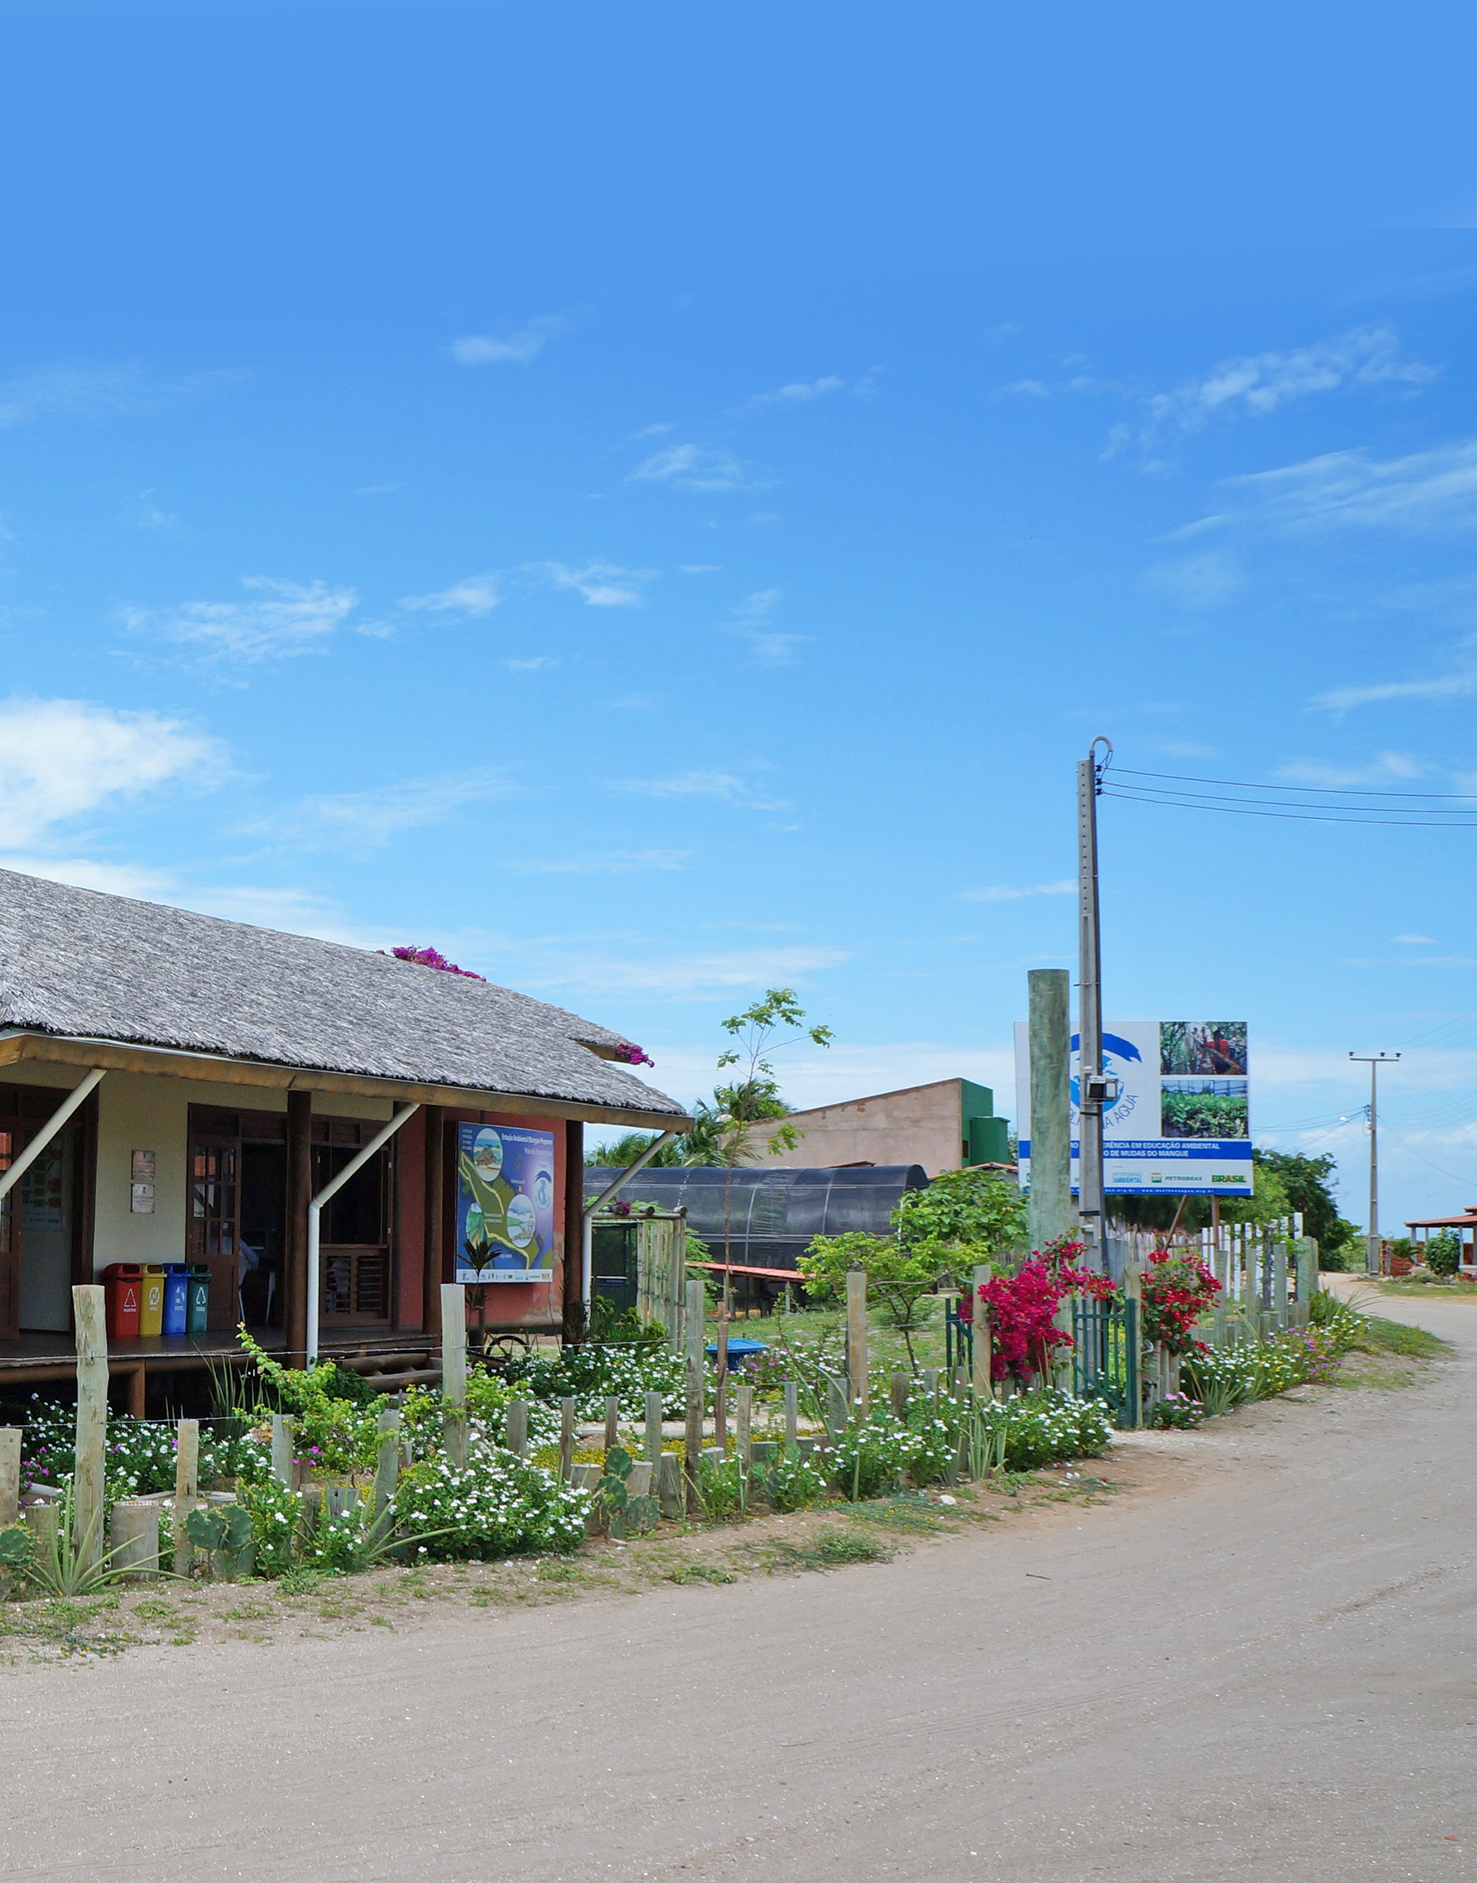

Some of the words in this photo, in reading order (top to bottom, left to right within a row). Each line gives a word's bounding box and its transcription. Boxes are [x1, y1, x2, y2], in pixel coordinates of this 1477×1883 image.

[1112, 1094, 1139, 1124] ÁGUA
[1102, 1141, 1130, 1149] ERÊNCIA
[1143, 1141, 1180, 1150] EDUCAÇÃO
[1211, 1174, 1247, 1183] BRASIL
